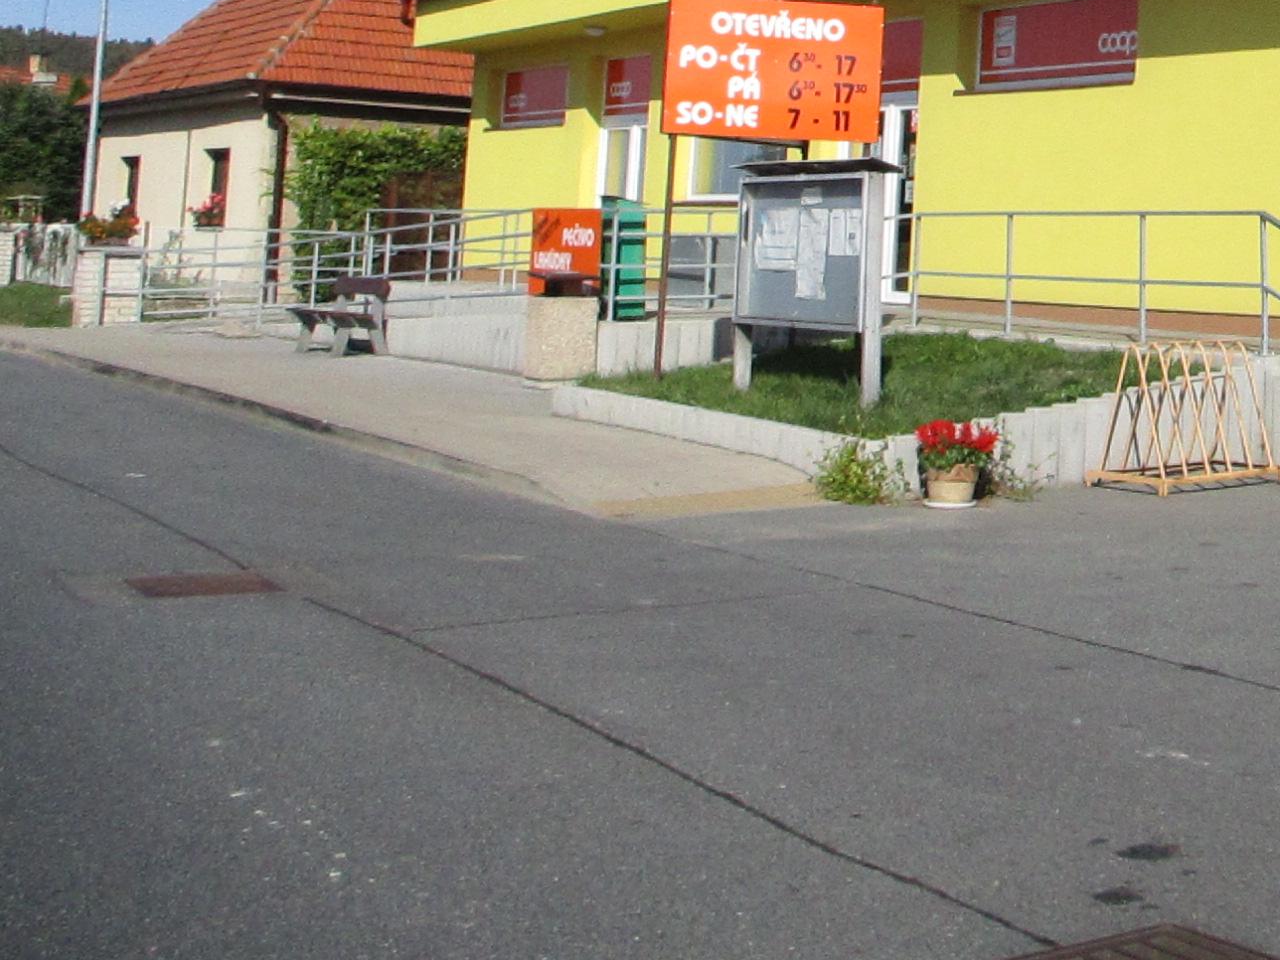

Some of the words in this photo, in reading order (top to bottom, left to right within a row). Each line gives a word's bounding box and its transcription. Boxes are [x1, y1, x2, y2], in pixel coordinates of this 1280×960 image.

[711, 10, 846, 42] OTEVŘENO
[835, 54, 857, 77] 17
[727, 71, 761, 101] PÁ
[788, 107, 801, 130] 7
[833, 110, 850, 132] 11
